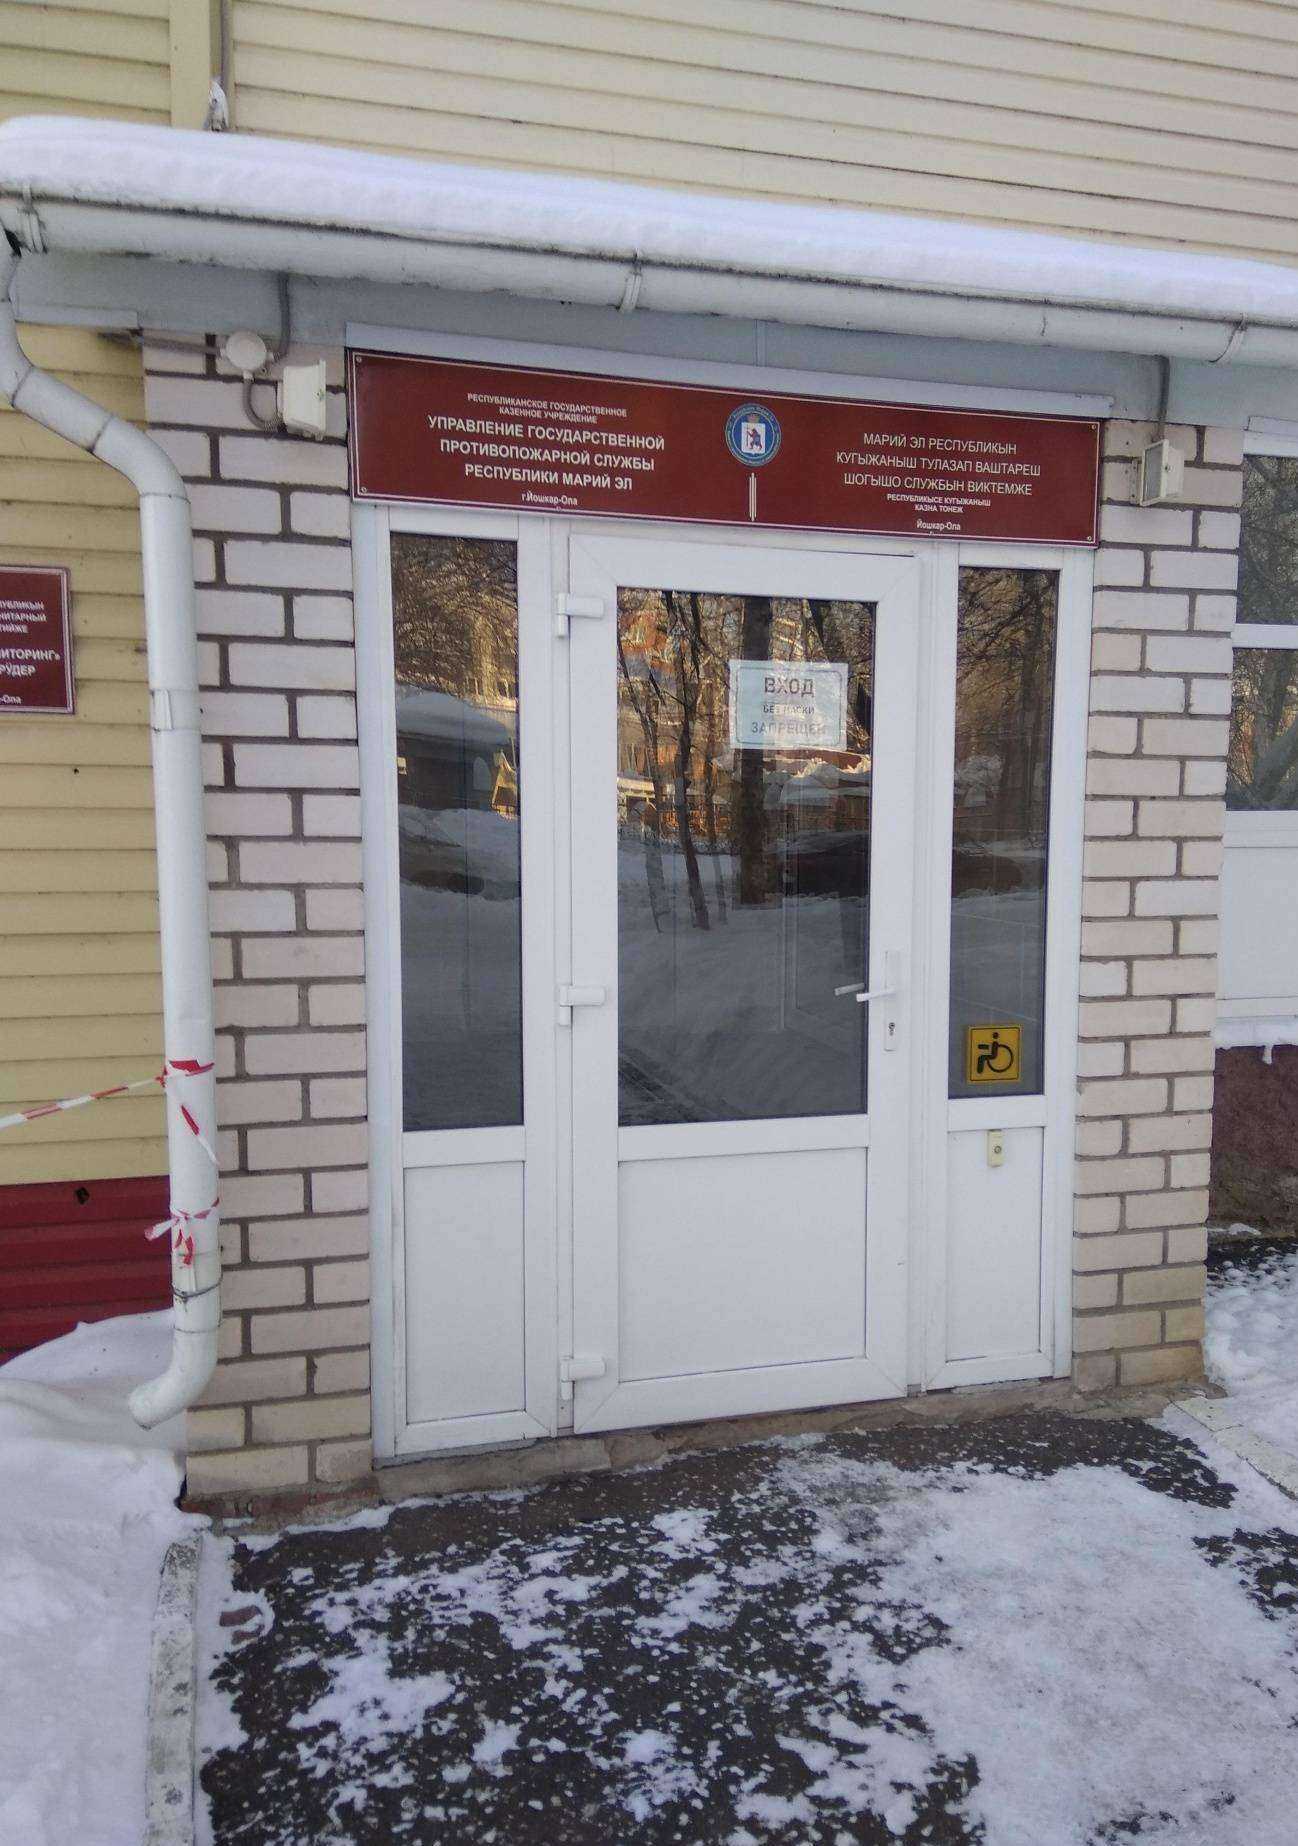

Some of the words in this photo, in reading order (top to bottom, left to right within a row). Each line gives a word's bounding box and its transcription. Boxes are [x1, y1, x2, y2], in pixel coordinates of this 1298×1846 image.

[468, 393, 548, 408] РЕСПУБЛИКАНСКОЕ
[550, 401, 627, 417] ГОСУДАРСТВЕННОЕ
[499, 407, 542, 419] КАЗЕННОЕ
[544, 411, 597, 424] УЧРЕЖДЕНИЕ
[428, 415, 524, 437] УПРАВЛЕНИЕ
[528, 425, 665, 450] ГОСУДАРСТВЕННОЙ
[440, 439, 591, 466] ПРОТИВОПОЖАРНОЙ
[594, 454, 655, 471] СЛУЖБЫ
[863, 433, 907, 447] МАРИЙ
[910, 437, 926, 449] ЭЛ
[929, 438, 1017, 455] РЕСПУБЛИКЫН
[837, 452, 917, 469] КУГЫЖАНЫШ
[920, 457, 972, 472] ТУЛАЗАП
[975, 461, 1040, 476] ВАШТАРЕШ
[464, 463, 559, 484] РЕСПУБЛИКИ
[562, 472, 611, 489] МАРИЙ
[614, 477, 633, 491] ЭЛ
[844, 473, 901, 488] ШОГЫШО
[904, 477, 965, 491] СЛУЖБЫН
[967, 481, 1033, 495] ВИКТЕМЖЕ
[887, 493, 943, 504] РЕСПУБЛИКЫСЕ
[944, 497, 991, 507] КУГЫЖАНЫШ
[914, 504, 938, 512] КАЗНА
[916, 519, 961, 531] Йошкар-Ола
[764, 677, 815, 698] ВХОД
